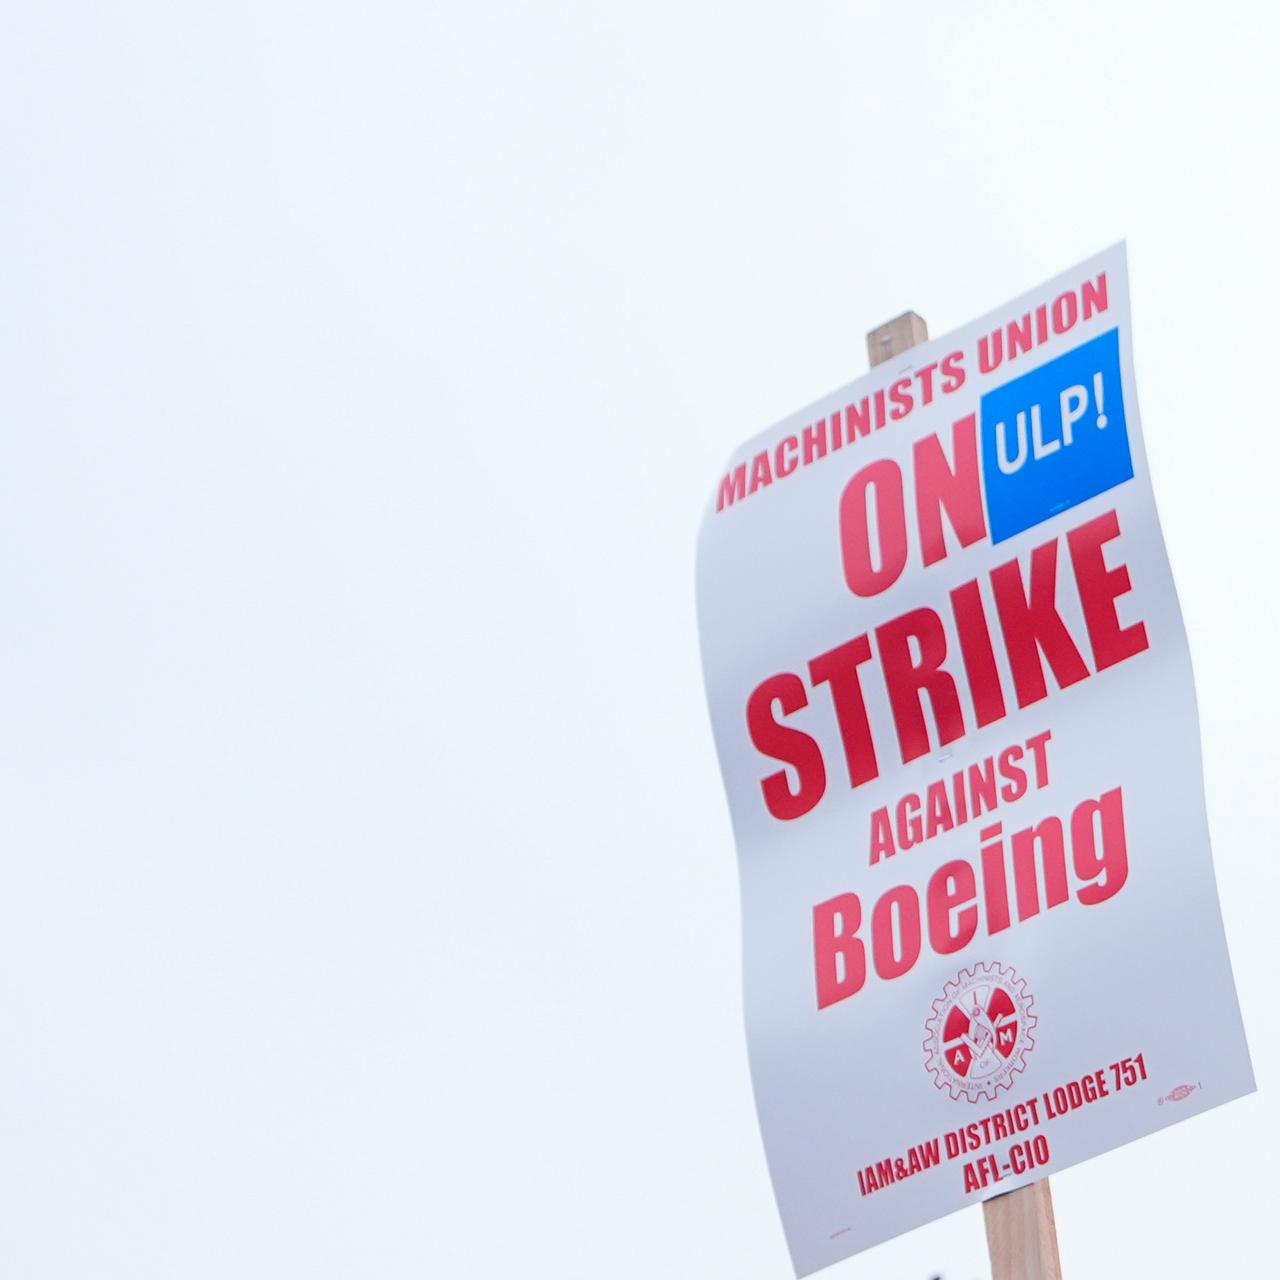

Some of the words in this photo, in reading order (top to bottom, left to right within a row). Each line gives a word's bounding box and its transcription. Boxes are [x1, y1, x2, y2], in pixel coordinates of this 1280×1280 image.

[716, 351, 967, 513] MACHINISTS
[978, 272, 1110, 376] UNION
[996, 372, 1107, 475] ULP!
[839, 412, 989, 598] ON
[745, 509, 1151, 823] STRIKE
[869, 730, 1053, 866] AGAINST
[813, 786, 1129, 1011] Boeing
[856, 1137, 941, 1196] IAM&AW
[944, 1098, 1041, 1161] DISTRICT
[1044, 1069, 1111, 1120] LODGE
[1108, 1054, 1148, 1093] 751
[963, 1134, 1051, 1195] AFL-CIO
